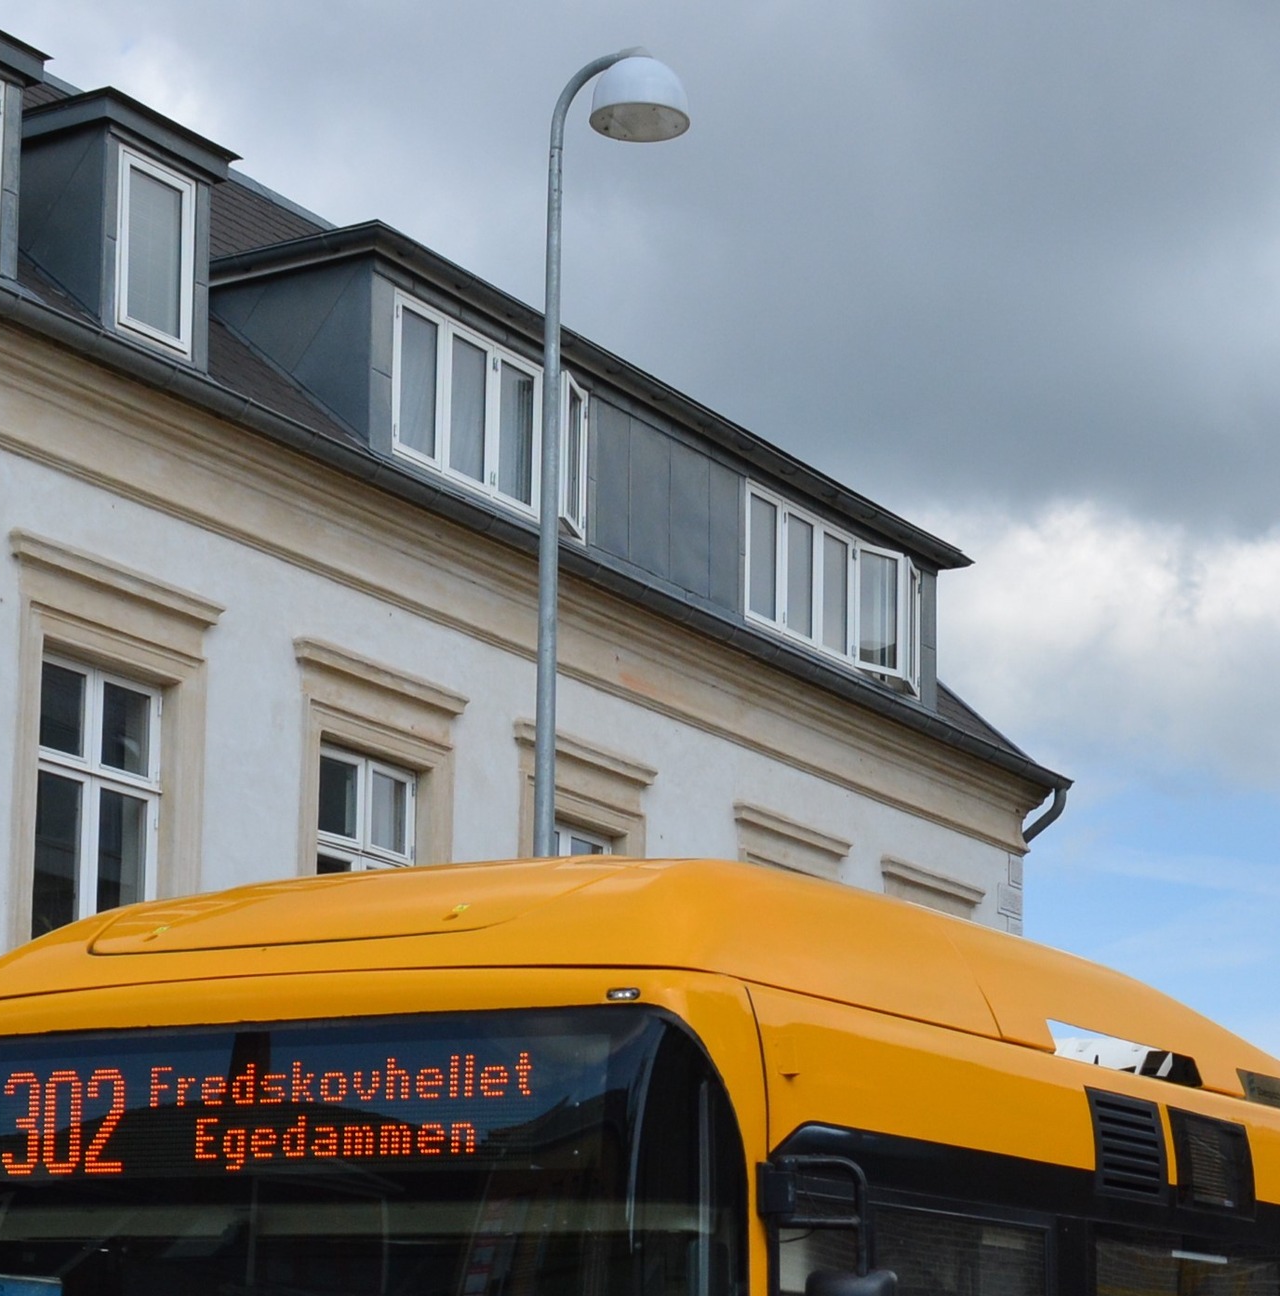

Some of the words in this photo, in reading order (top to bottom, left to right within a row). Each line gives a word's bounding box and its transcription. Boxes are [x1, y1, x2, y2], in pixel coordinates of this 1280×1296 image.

[2, 1067, 125, 1175] 302
[149, 1052, 532, 1108] Fredskovhellet
[195, 1116, 476, 1171] Egedammen
